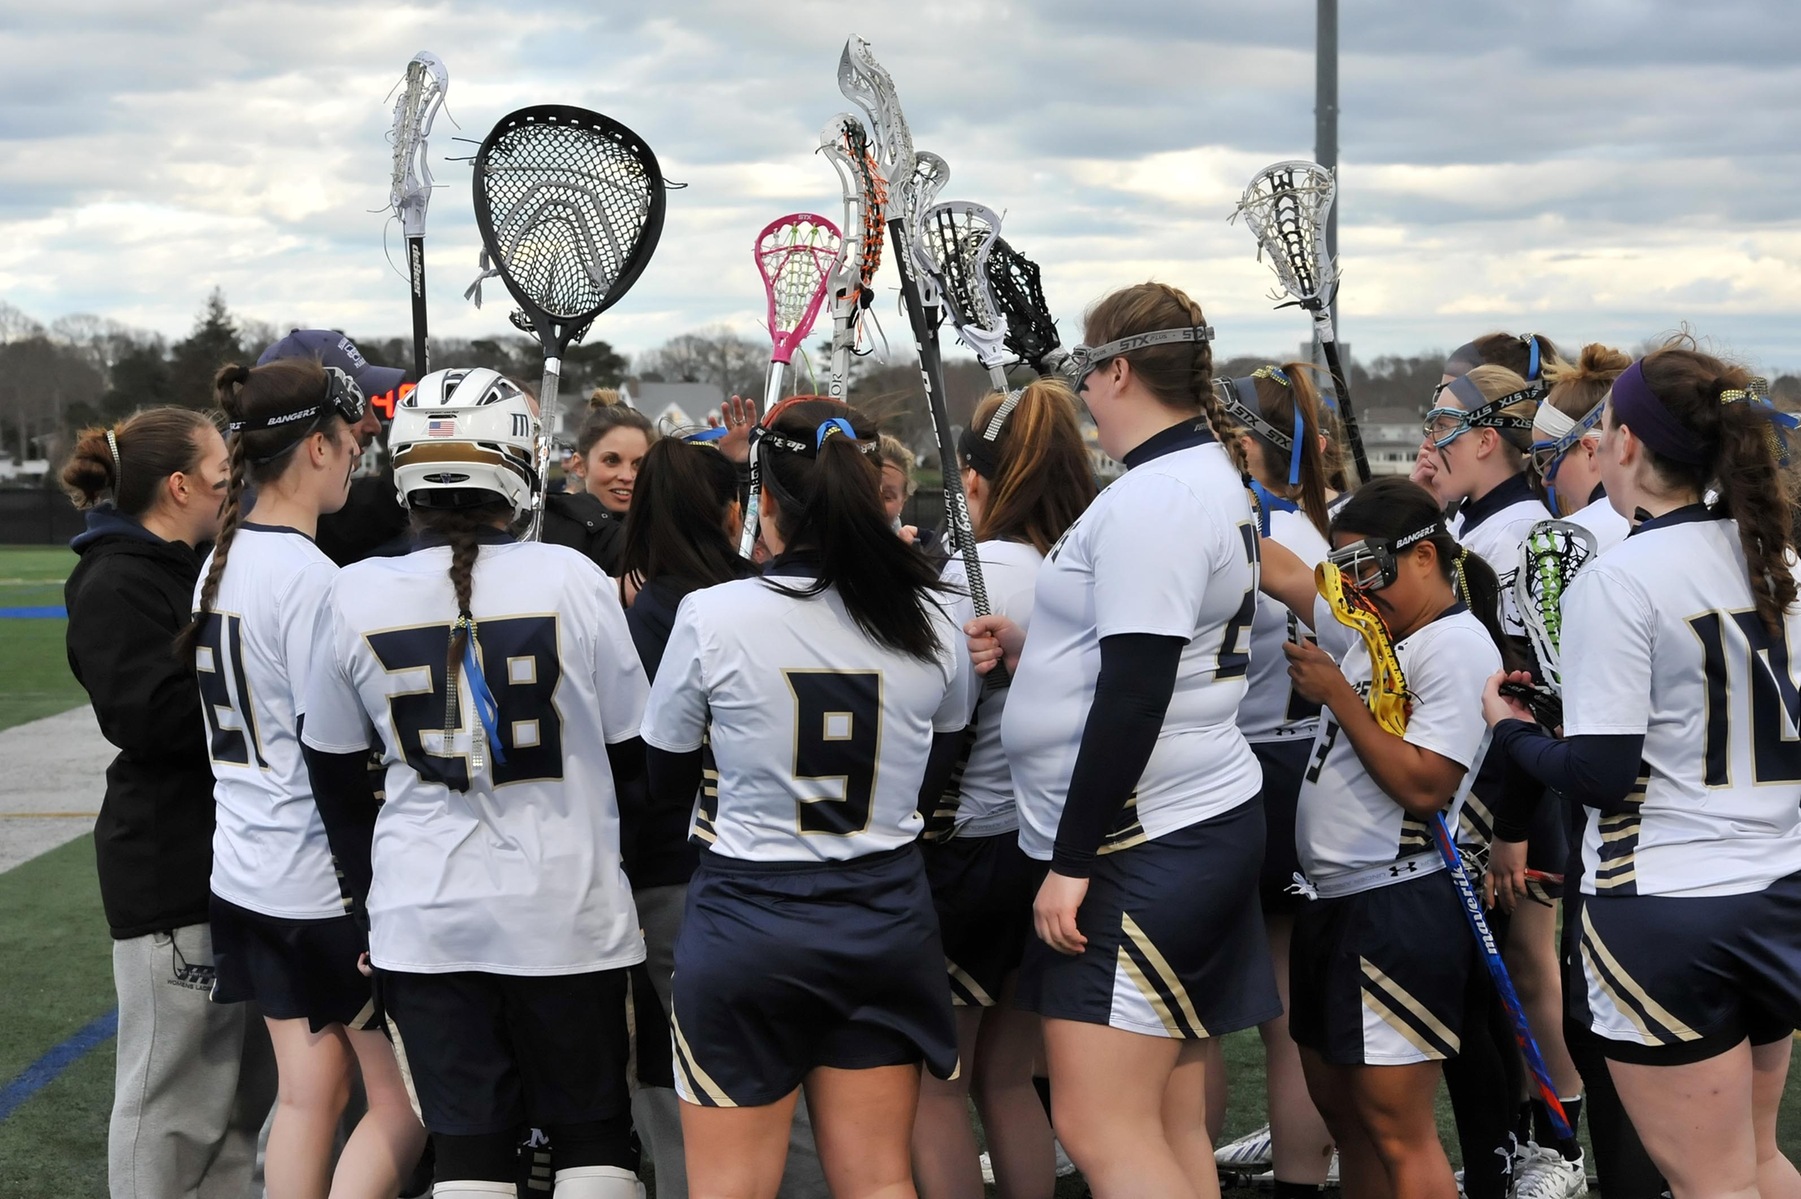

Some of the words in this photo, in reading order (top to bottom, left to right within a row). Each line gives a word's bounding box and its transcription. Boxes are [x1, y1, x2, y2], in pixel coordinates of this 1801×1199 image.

[412, 243, 421, 298] deBeer
[898, 227, 916, 282] deBeer
[1119, 335, 1150, 351] STX
[267, 406, 317, 426] BANGERZ
[1234, 406, 1259, 427] STX
[1265, 429, 1291, 448] STX
[1466, 405, 1493, 424] STX
[1498, 392, 1523, 408] STX
[1478, 417, 1504, 427] STX
[955, 492, 972, 532] 6000
[1396, 524, 1437, 549] BANGERZ
[360, 612, 565, 796] 28
[779, 667, 885, 838] 9
[1450, 864, 1498, 955] maverik
